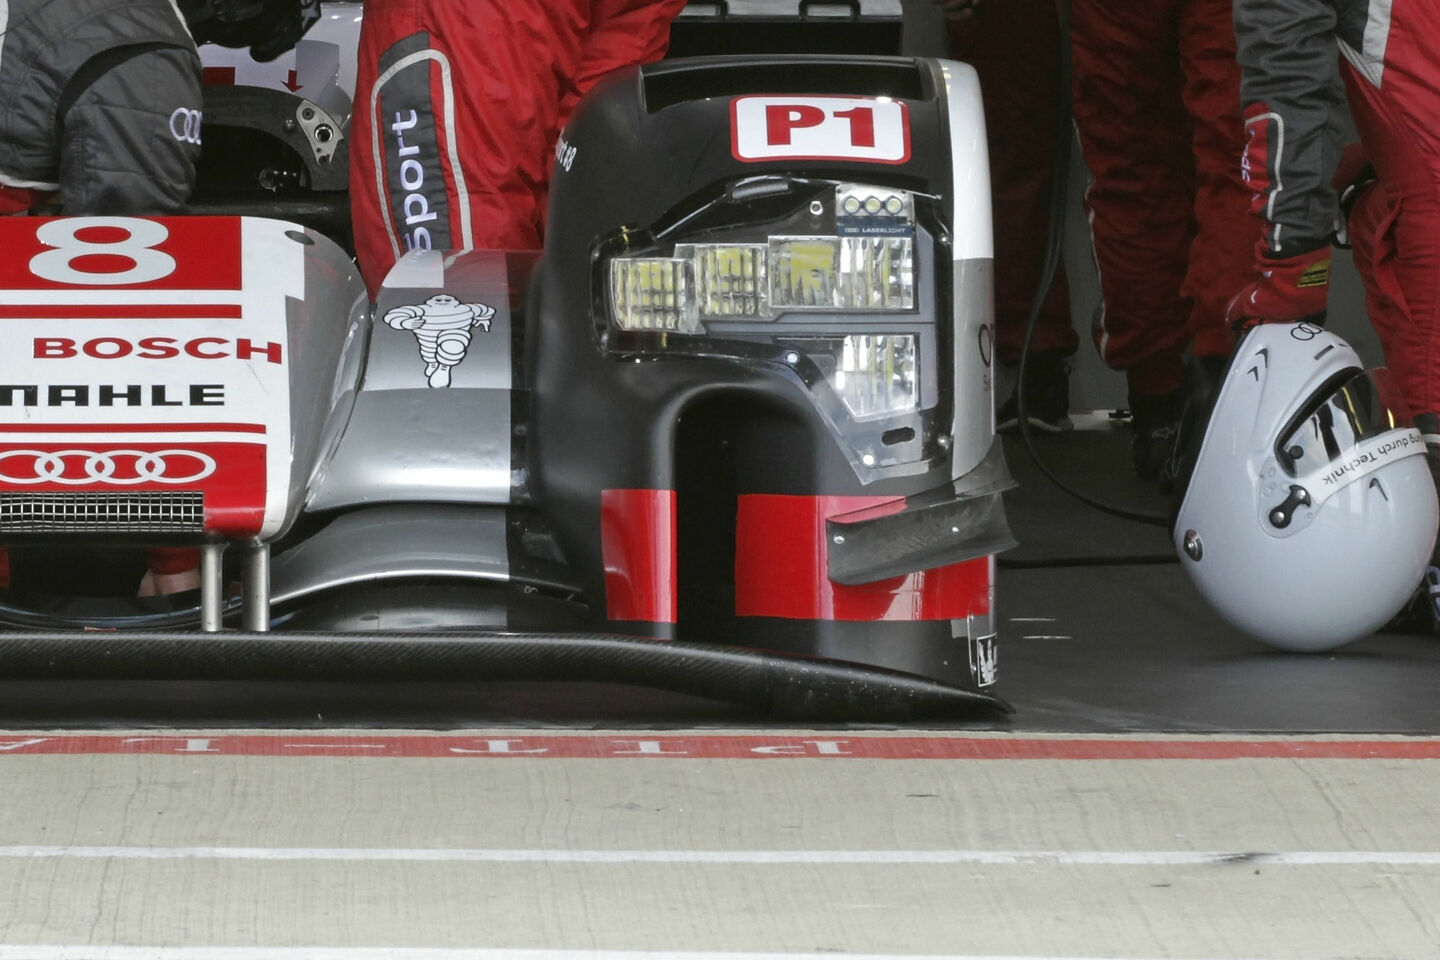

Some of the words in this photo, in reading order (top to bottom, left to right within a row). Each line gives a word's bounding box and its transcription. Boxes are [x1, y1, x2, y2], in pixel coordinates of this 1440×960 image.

[765, 104, 876, 148] P1
[27, 216, 178, 287] 8
[33, 336, 282, 365] BOSCH
[1377, 438, 1409, 456] durch
[1322, 451, 1376, 486] Technik
